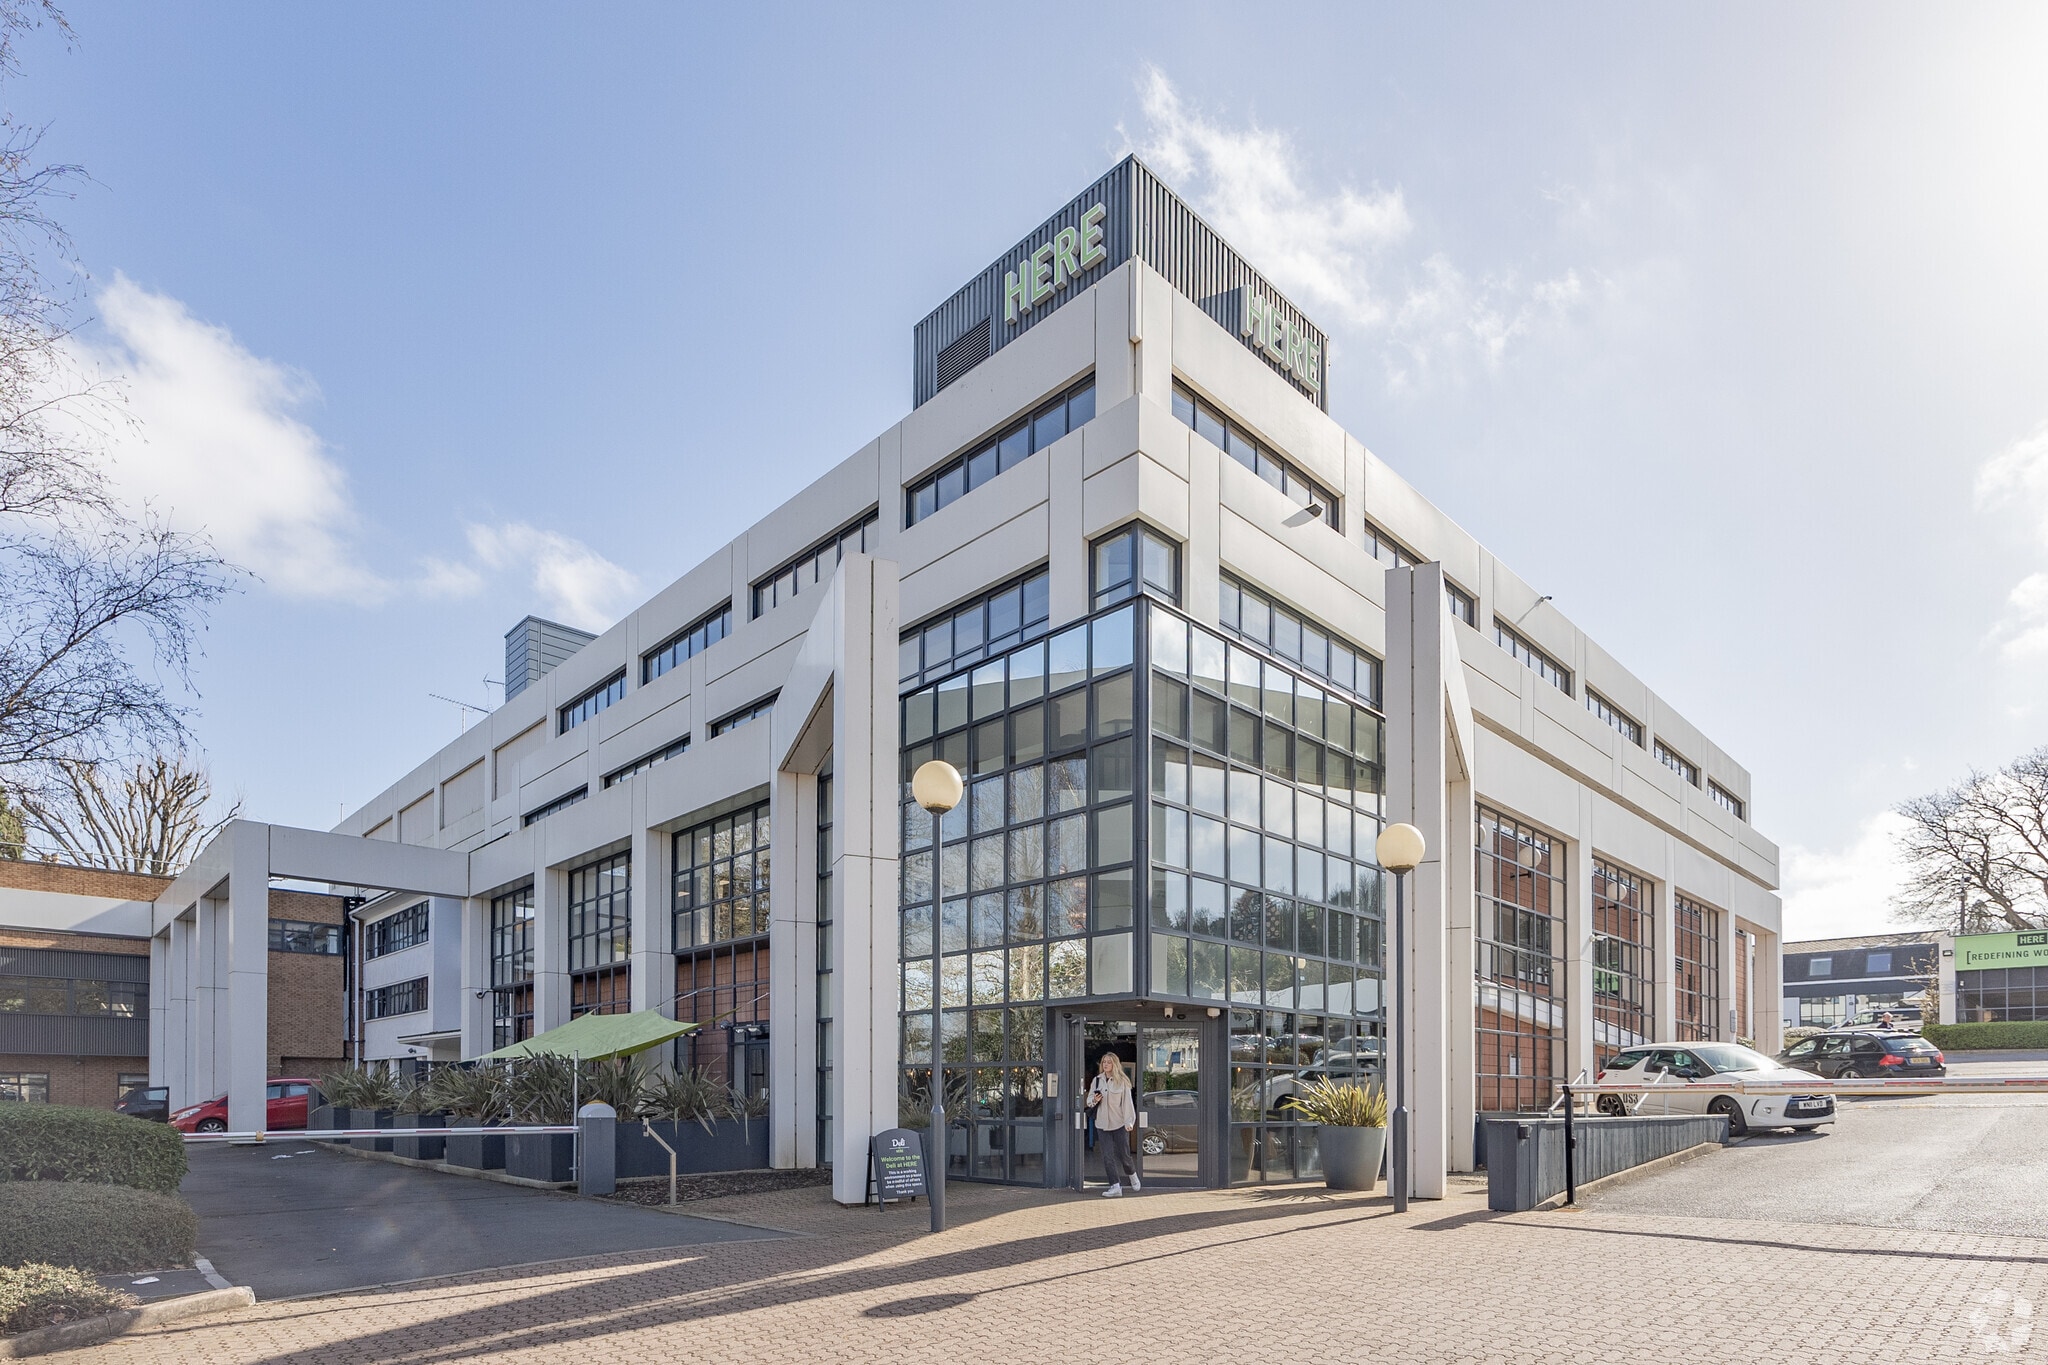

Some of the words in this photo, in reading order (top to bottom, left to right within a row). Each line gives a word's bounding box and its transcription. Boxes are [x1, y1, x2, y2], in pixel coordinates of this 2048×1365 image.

[1004, 202, 1107, 325] HERE
[1241, 284, 1320, 393] HERE
[2019, 934, 2045, 944] HERE
[891, 1137, 906, 1147] Deli
